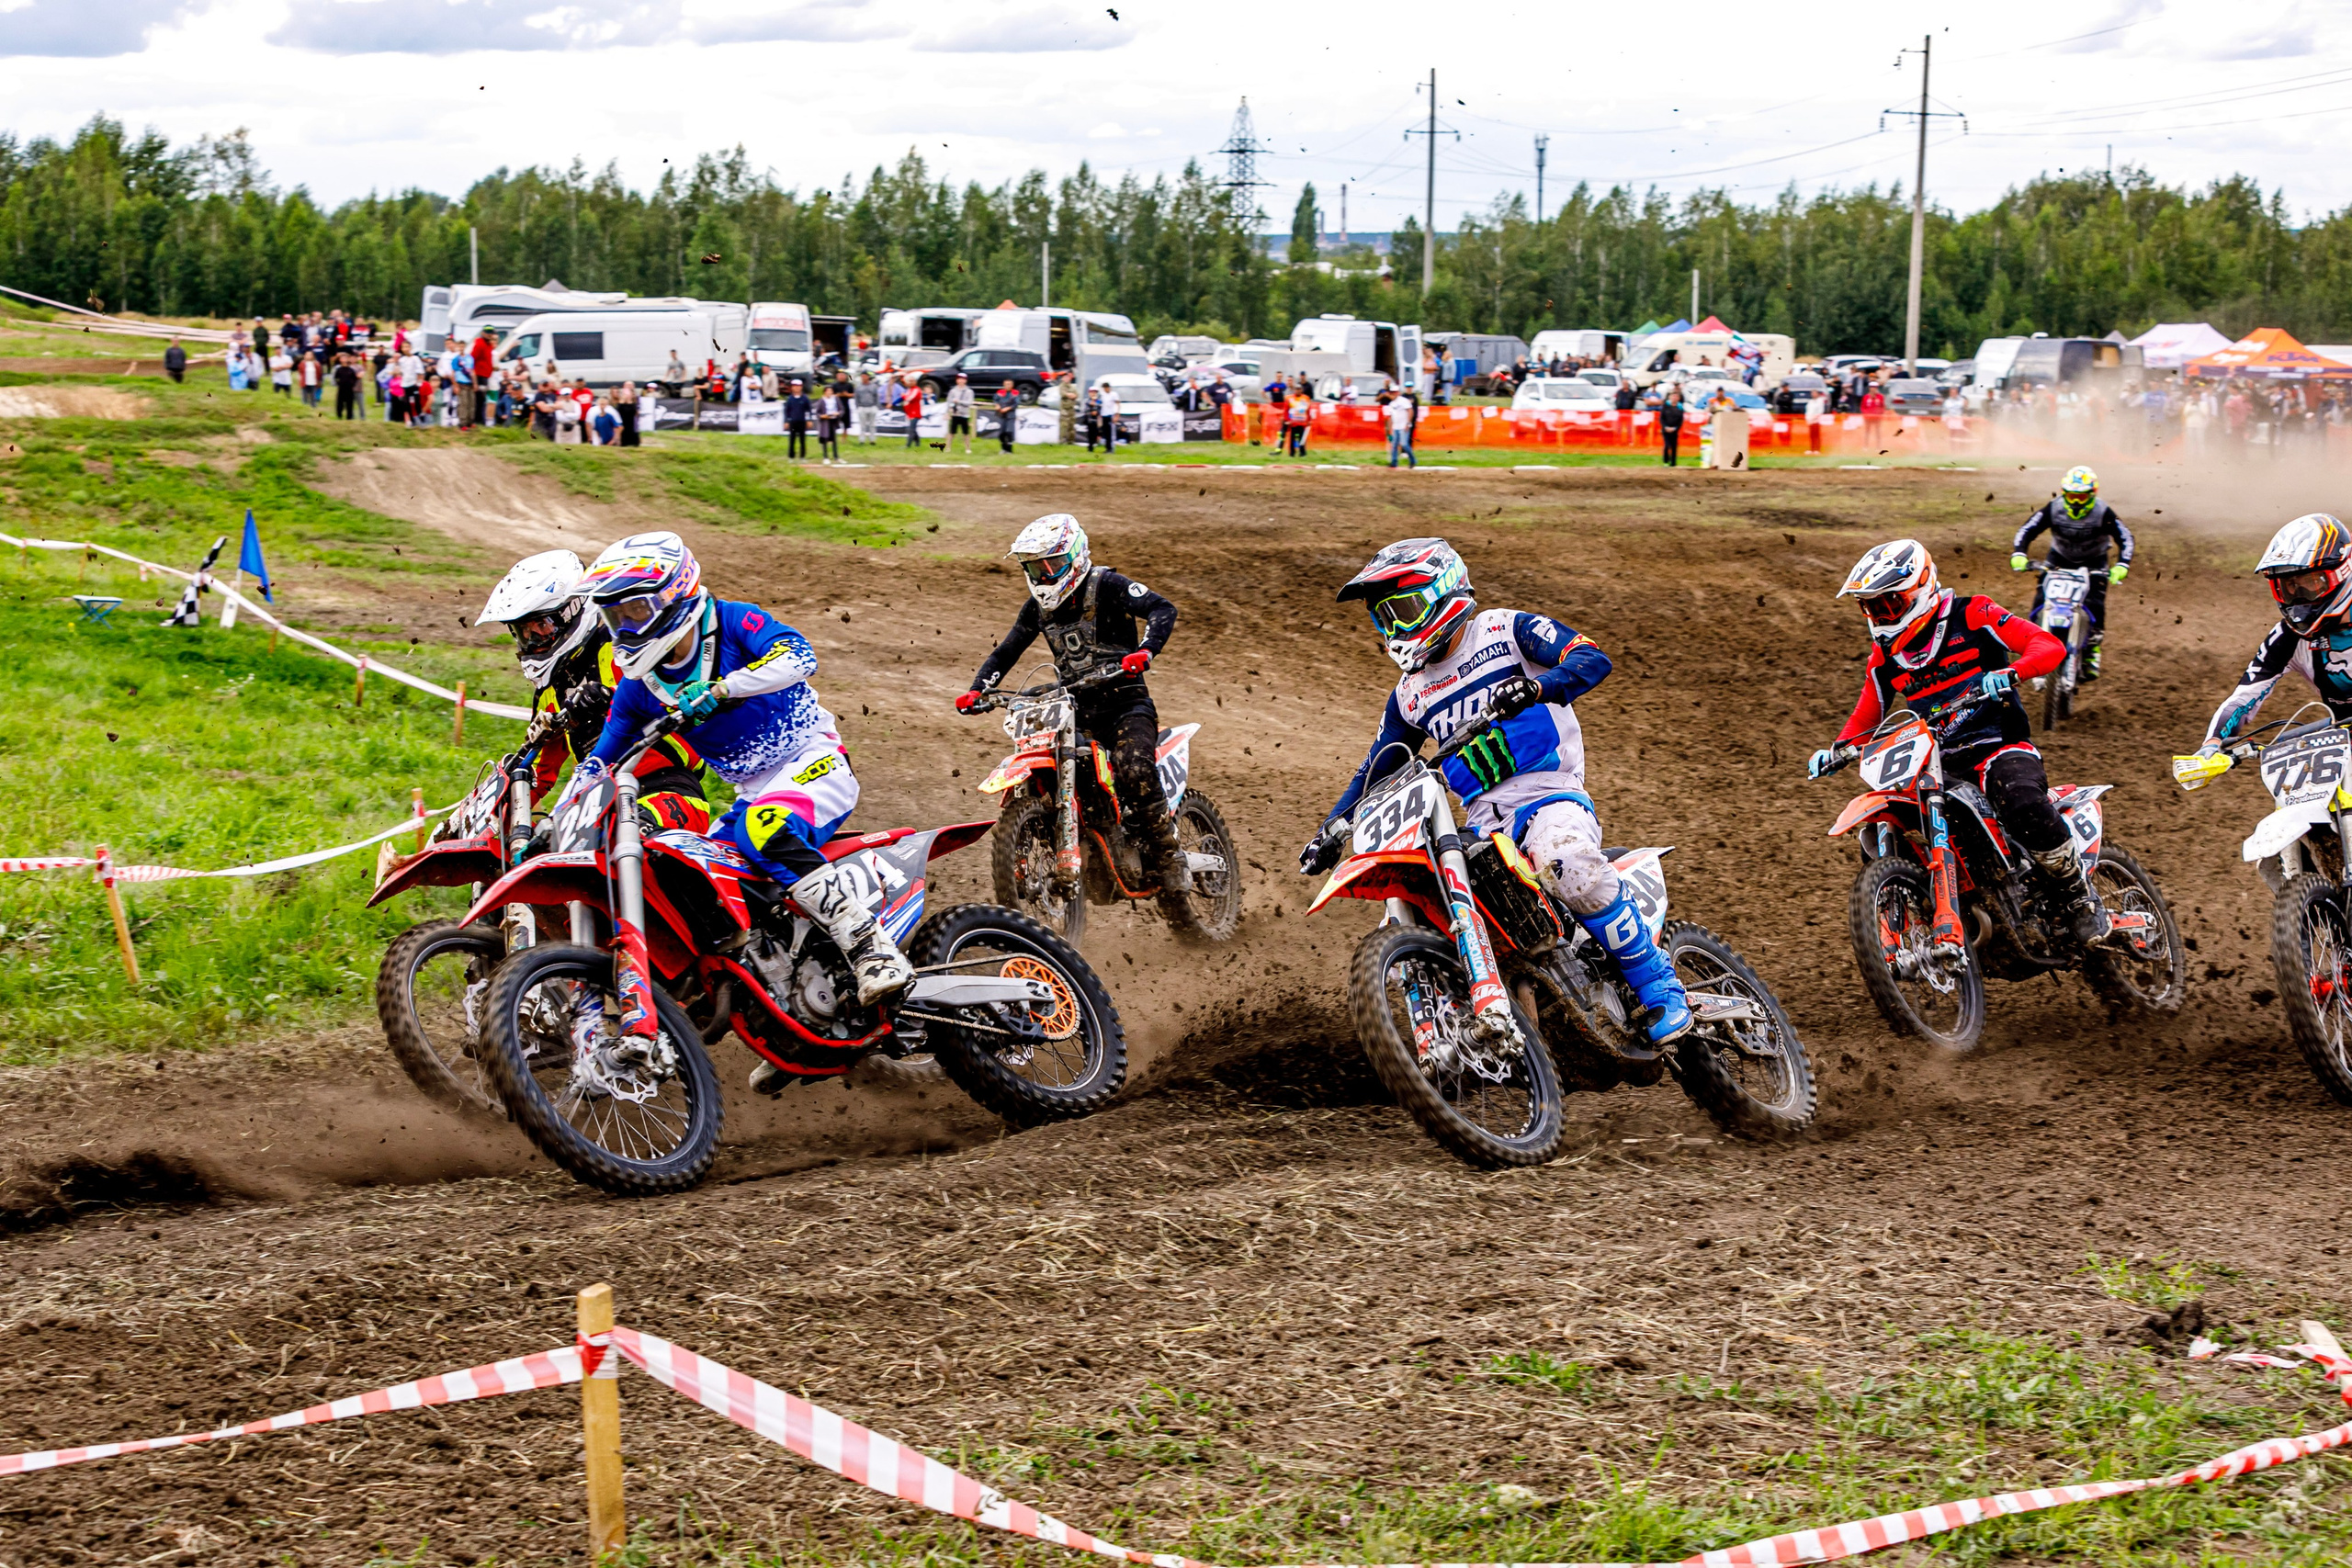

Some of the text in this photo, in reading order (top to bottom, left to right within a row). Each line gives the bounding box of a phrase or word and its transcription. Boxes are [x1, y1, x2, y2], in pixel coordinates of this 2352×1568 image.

[2267, 352, 2320, 363] KTM
[1420, 675, 1458, 698] ESCONDIDO
[1430, 674, 1452, 686] TOYOTA
[1879, 740, 1916, 784] 6
[2267, 748, 2344, 797] 776
[559, 784, 604, 852] 24
[1363, 784, 1426, 853] 334
[2071, 813, 2098, 841] 6
[836, 849, 908, 909] 24
[1623, 869, 1666, 918] 34
[1948, 863, 1956, 898] VECTOR
[1472, 984, 1508, 1002] KTM
